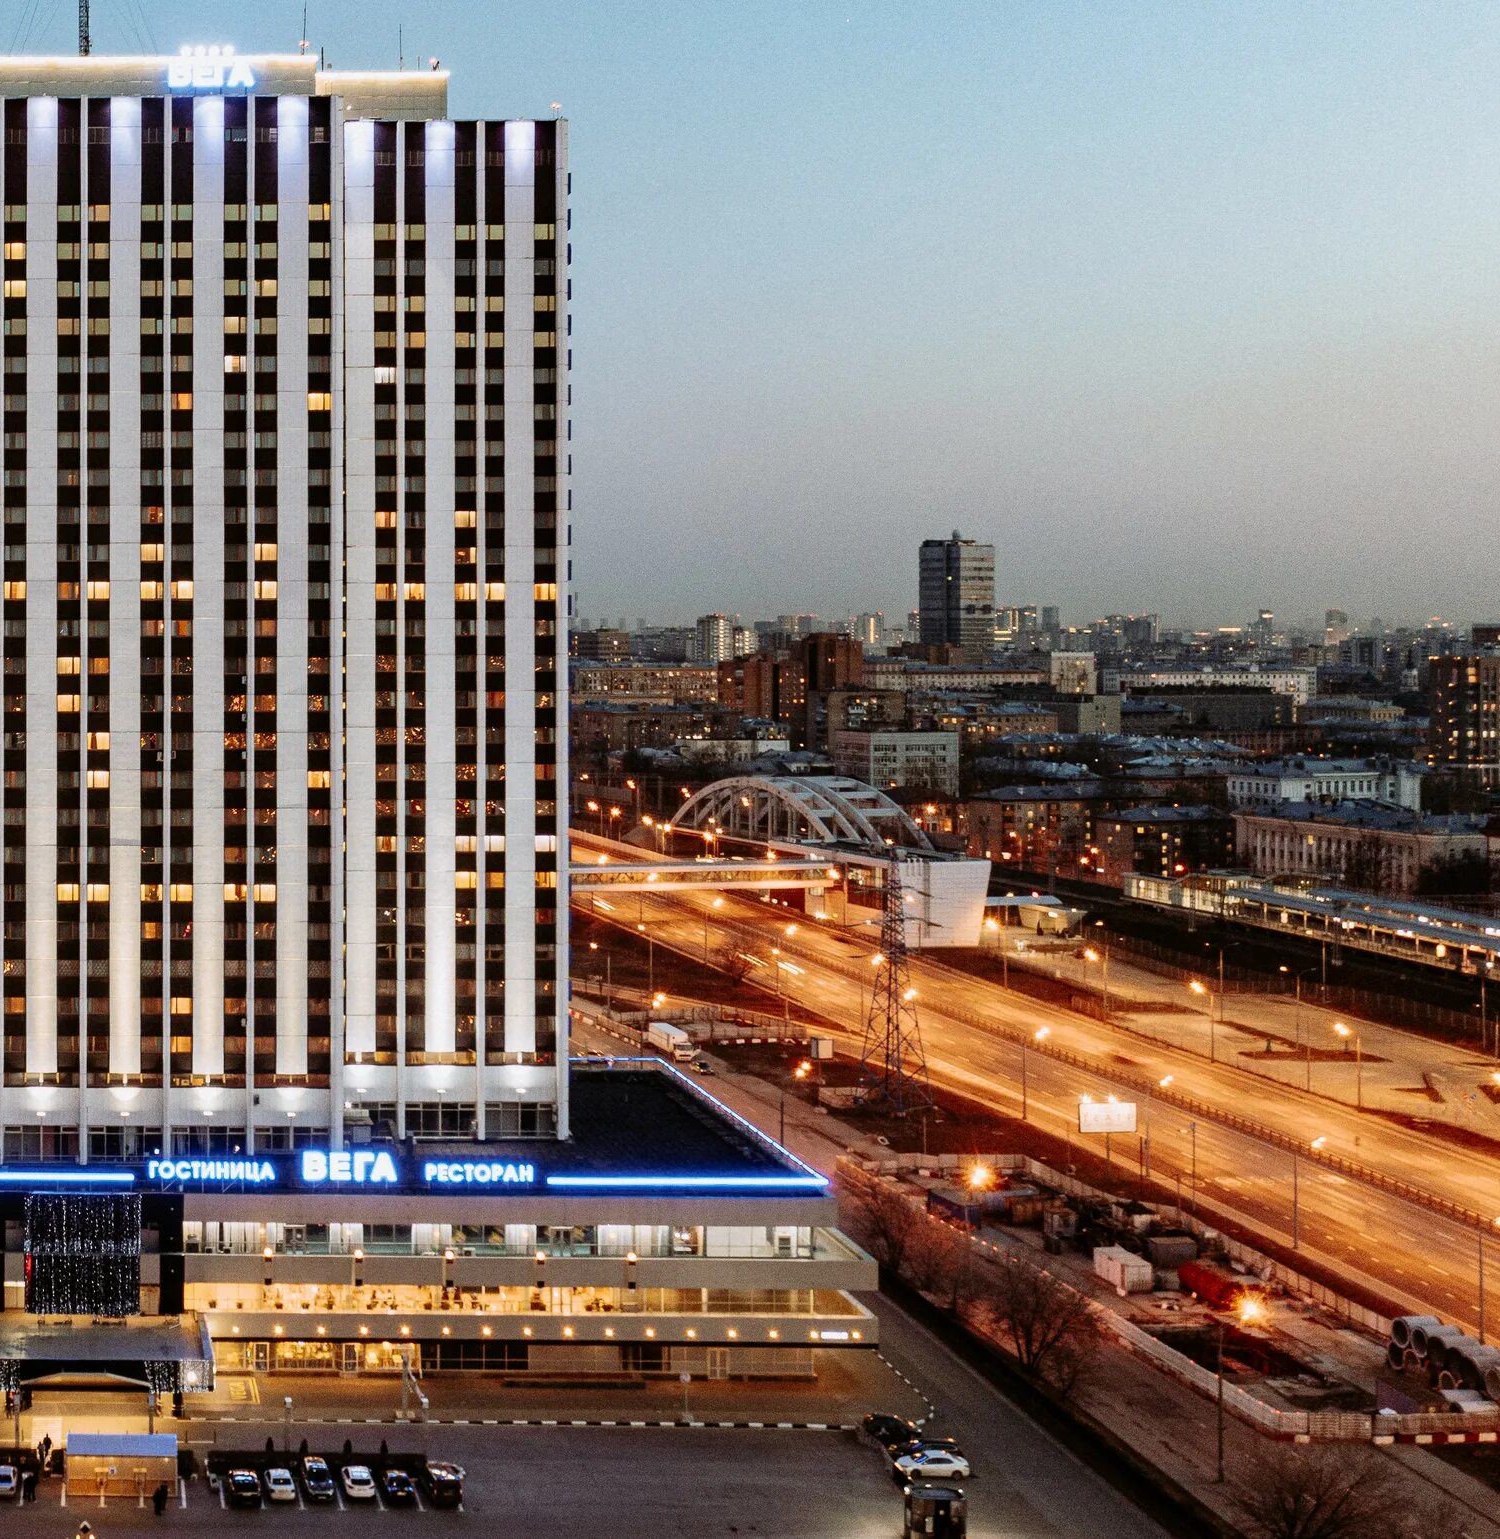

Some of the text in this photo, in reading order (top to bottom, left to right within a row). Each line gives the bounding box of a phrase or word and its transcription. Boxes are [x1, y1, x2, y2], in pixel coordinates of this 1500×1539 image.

[148, 1151, 534, 1183] ГОСТИНИЦА ВЕГА РЕСТОРАН
